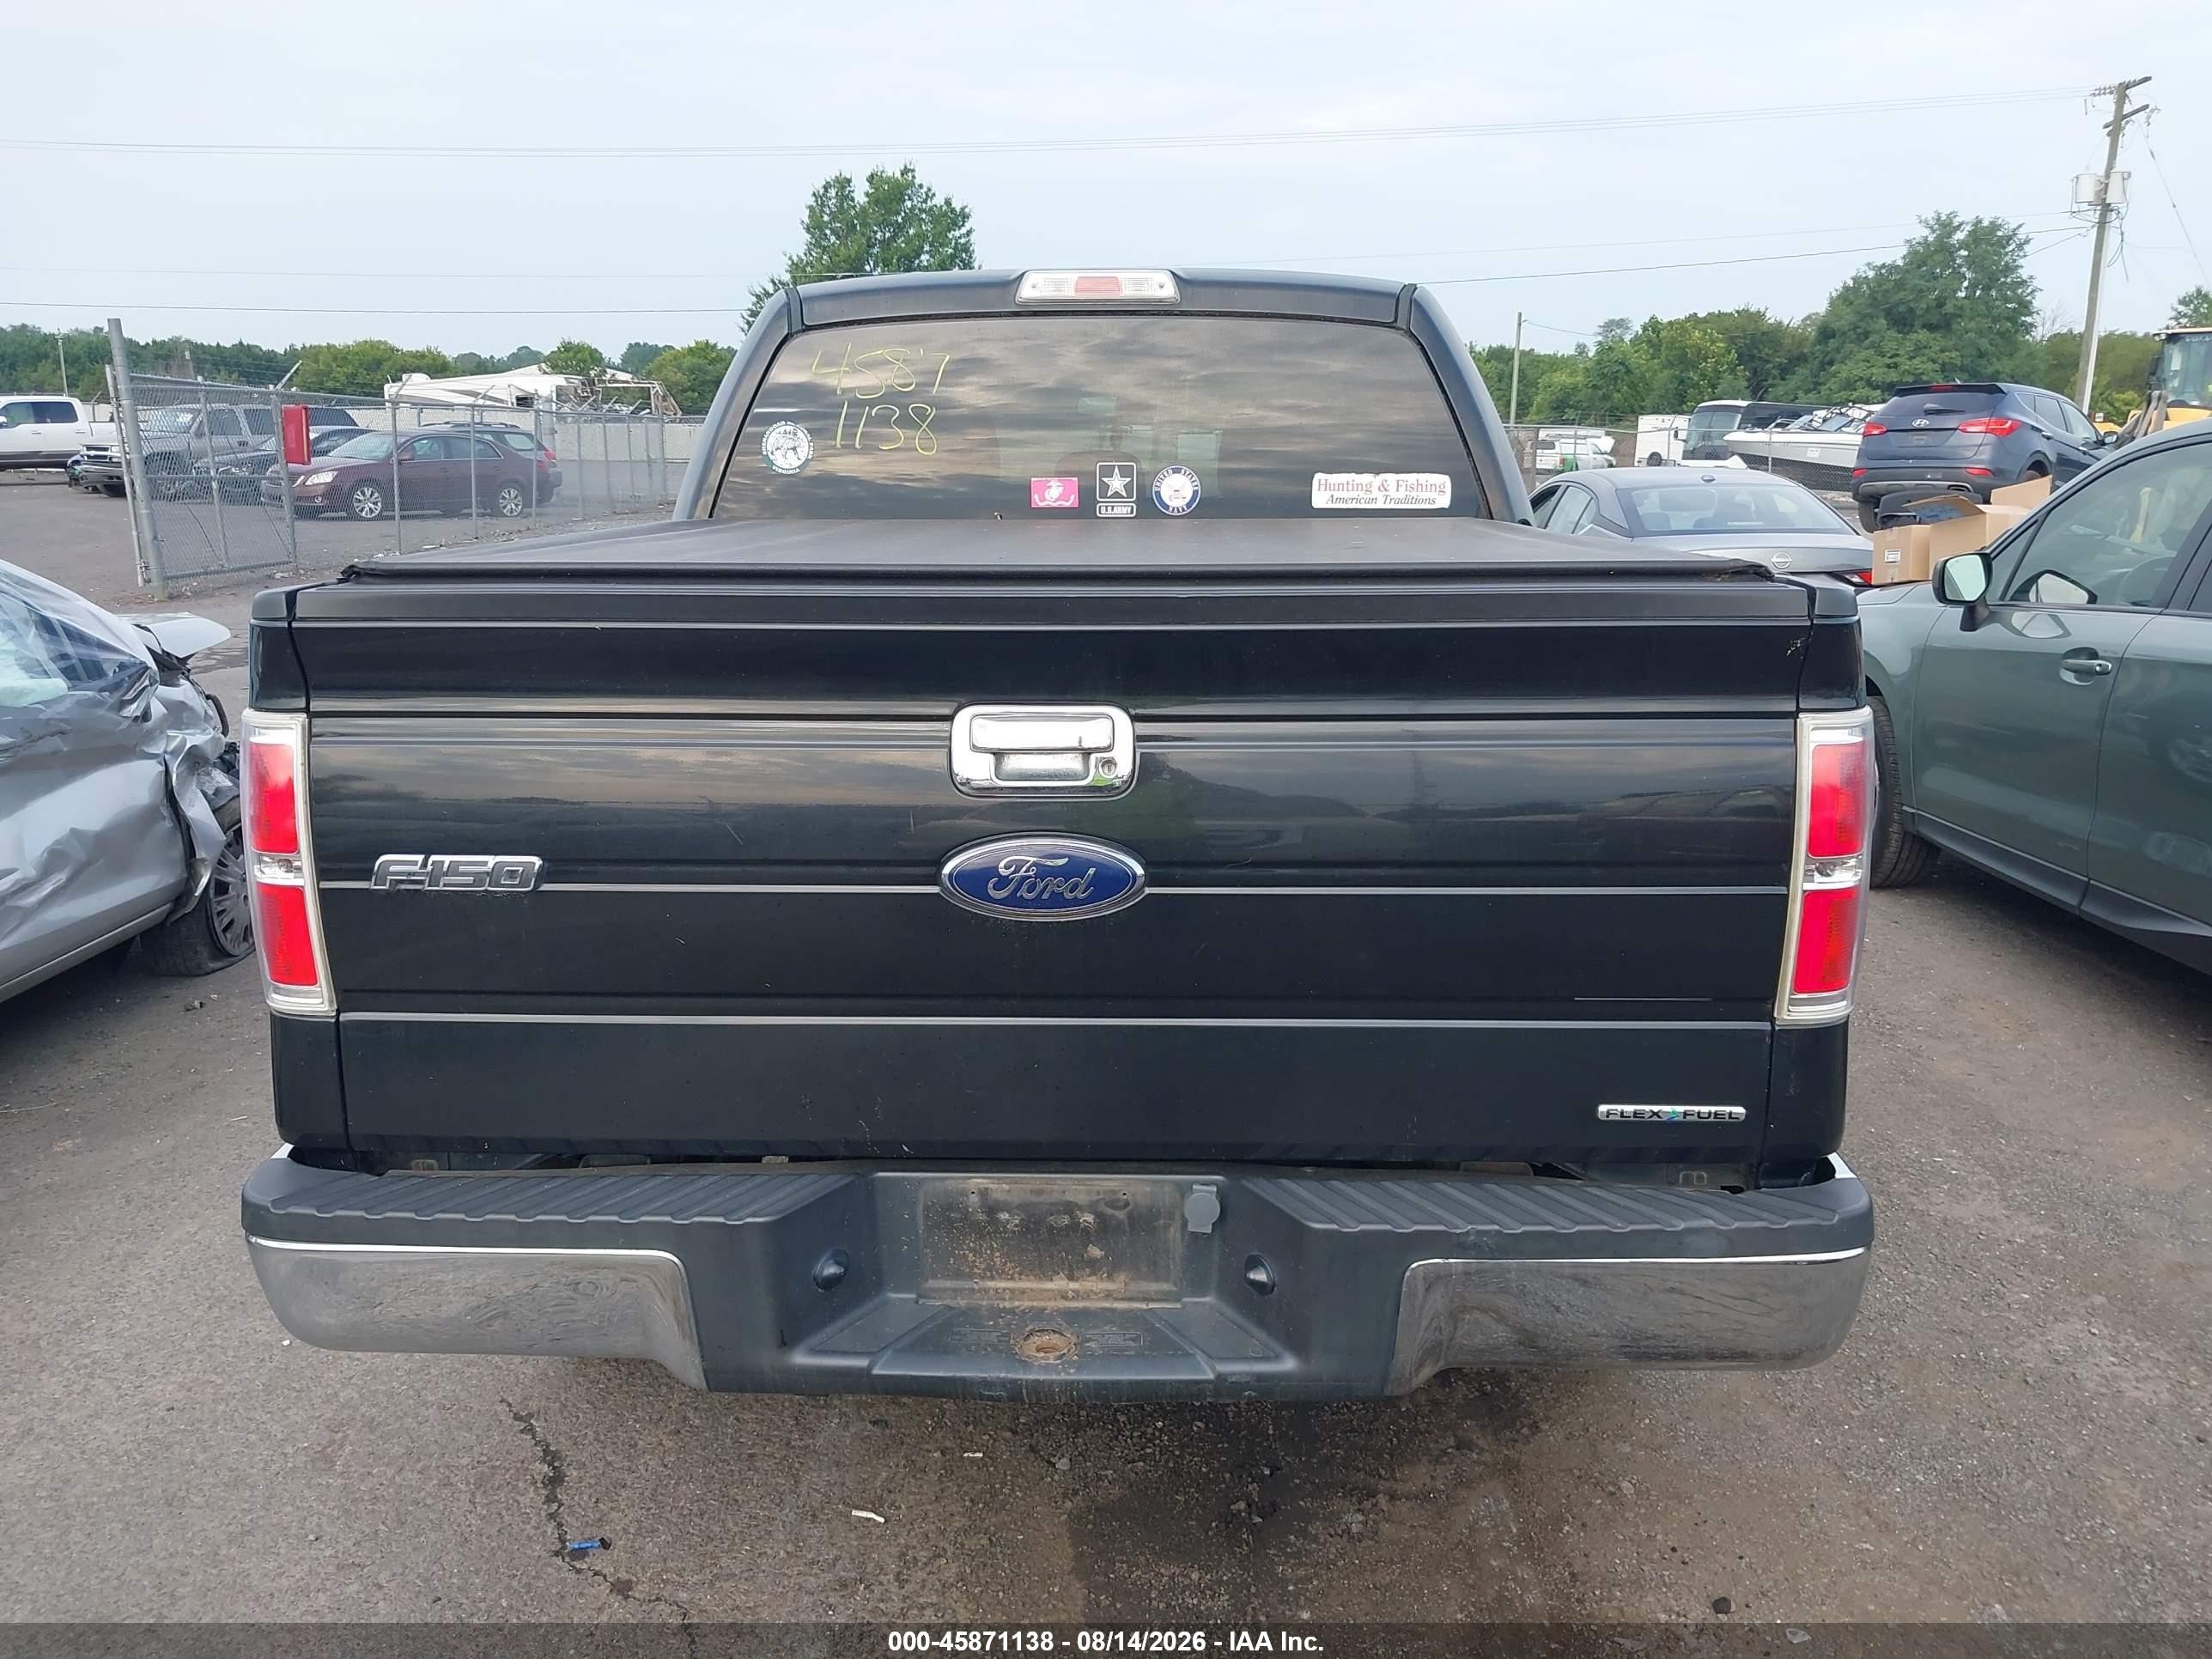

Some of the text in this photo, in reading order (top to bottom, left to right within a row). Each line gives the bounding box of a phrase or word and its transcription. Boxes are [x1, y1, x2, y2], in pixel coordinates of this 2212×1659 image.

[836, 400, 937, 454] 1138
[772, 465, 801, 474] VIRGINIA
[1154, 469, 1199, 491] UNITED STATES
[1317, 478, 1446, 495] Hunting & Fishing
[1326, 495, 1437, 505] American Traditions
[370, 854, 543, 890] F-150
[988, 855, 1097, 900] Ford
[1605, 1109, 1741, 1120] FLEX FUEL
